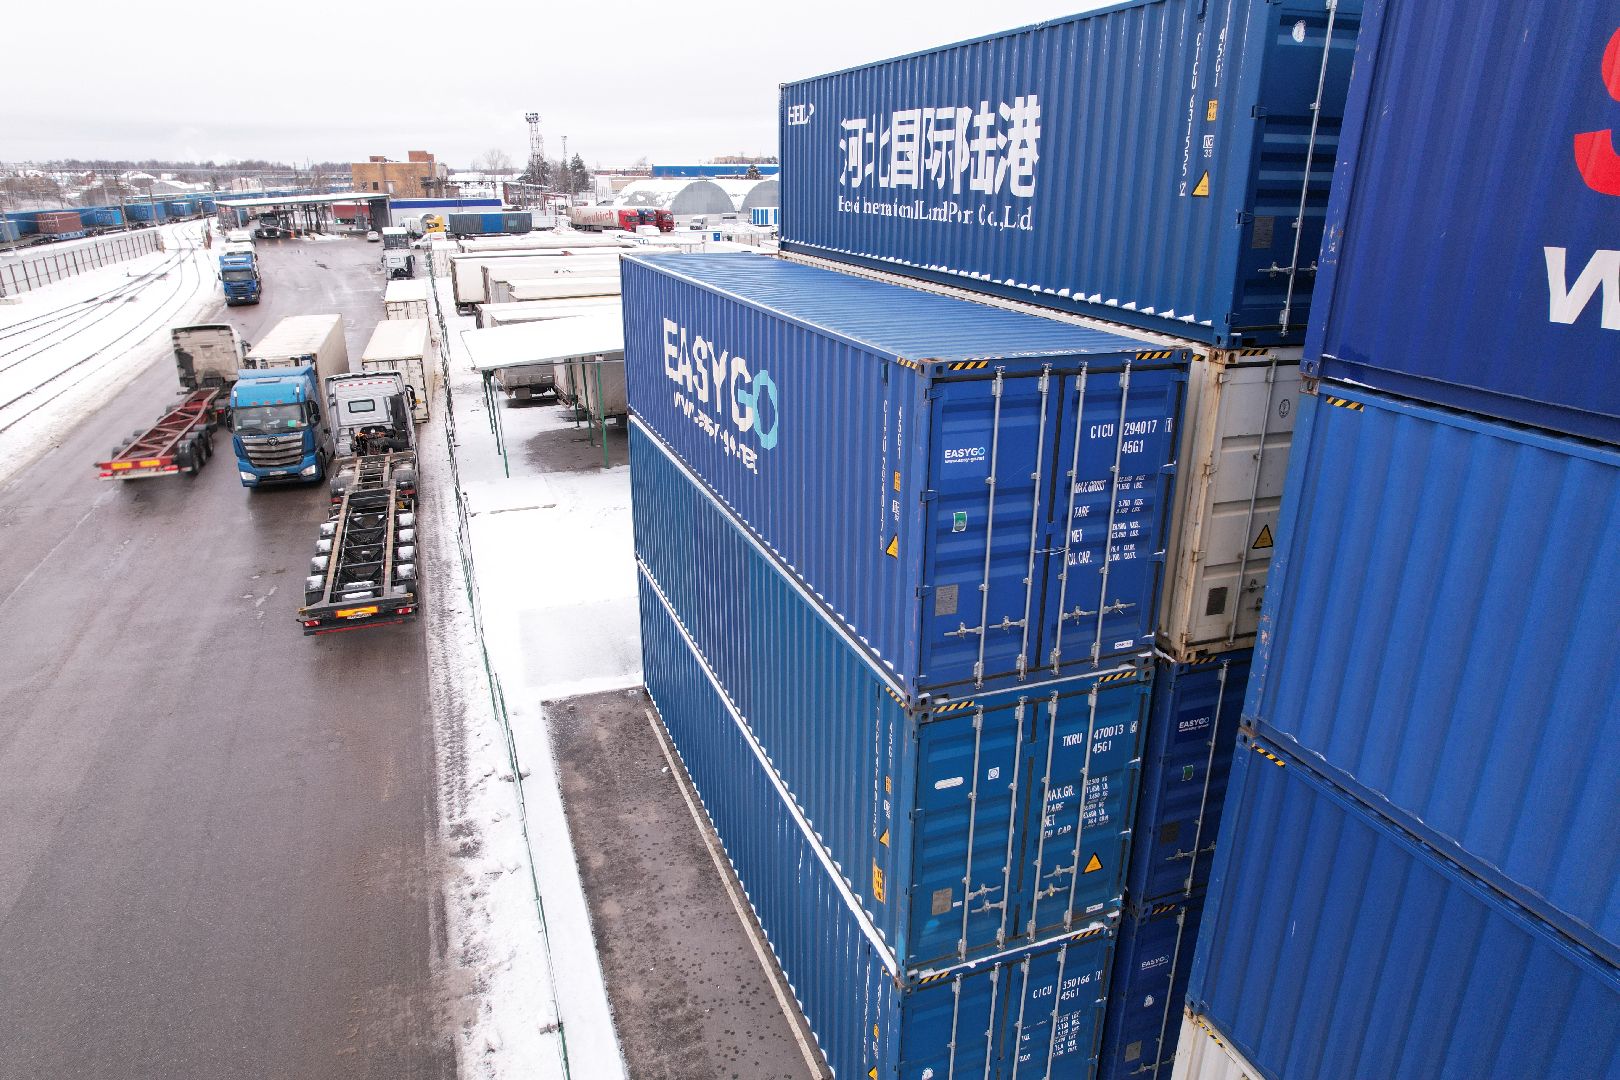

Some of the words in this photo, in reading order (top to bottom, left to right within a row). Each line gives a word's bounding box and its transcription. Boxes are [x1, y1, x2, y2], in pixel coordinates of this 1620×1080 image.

[1214, 27, 1226, 88] 45G1
[1182, 94, 1195, 177] 631555
[838, 94, 1041, 198] 河北国际陆港
[664, 317, 779, 451] EASYGO
[1090, 423, 1114, 439] CICU
[1123, 419, 1158, 436] 294017
[944, 447, 986, 459] EASYGO
[1121, 440, 1144, 454] 45G1
[1073, 505, 1090, 518] TARE
[1071, 529, 1083, 543] NET
[1078, 550, 1093, 564] CAP.
[1179, 717, 1210, 729] EASYGO
[1062, 732, 1083, 747] TKRU
[1093, 724, 1124, 740] 470013
[1092, 740, 1112, 754] 45G1
[1044, 814, 1056, 828] NET
[1032, 985, 1053, 999] CICU
[1062, 973, 1091, 990] 350166
[1060, 987, 1080, 1001] 45G1
